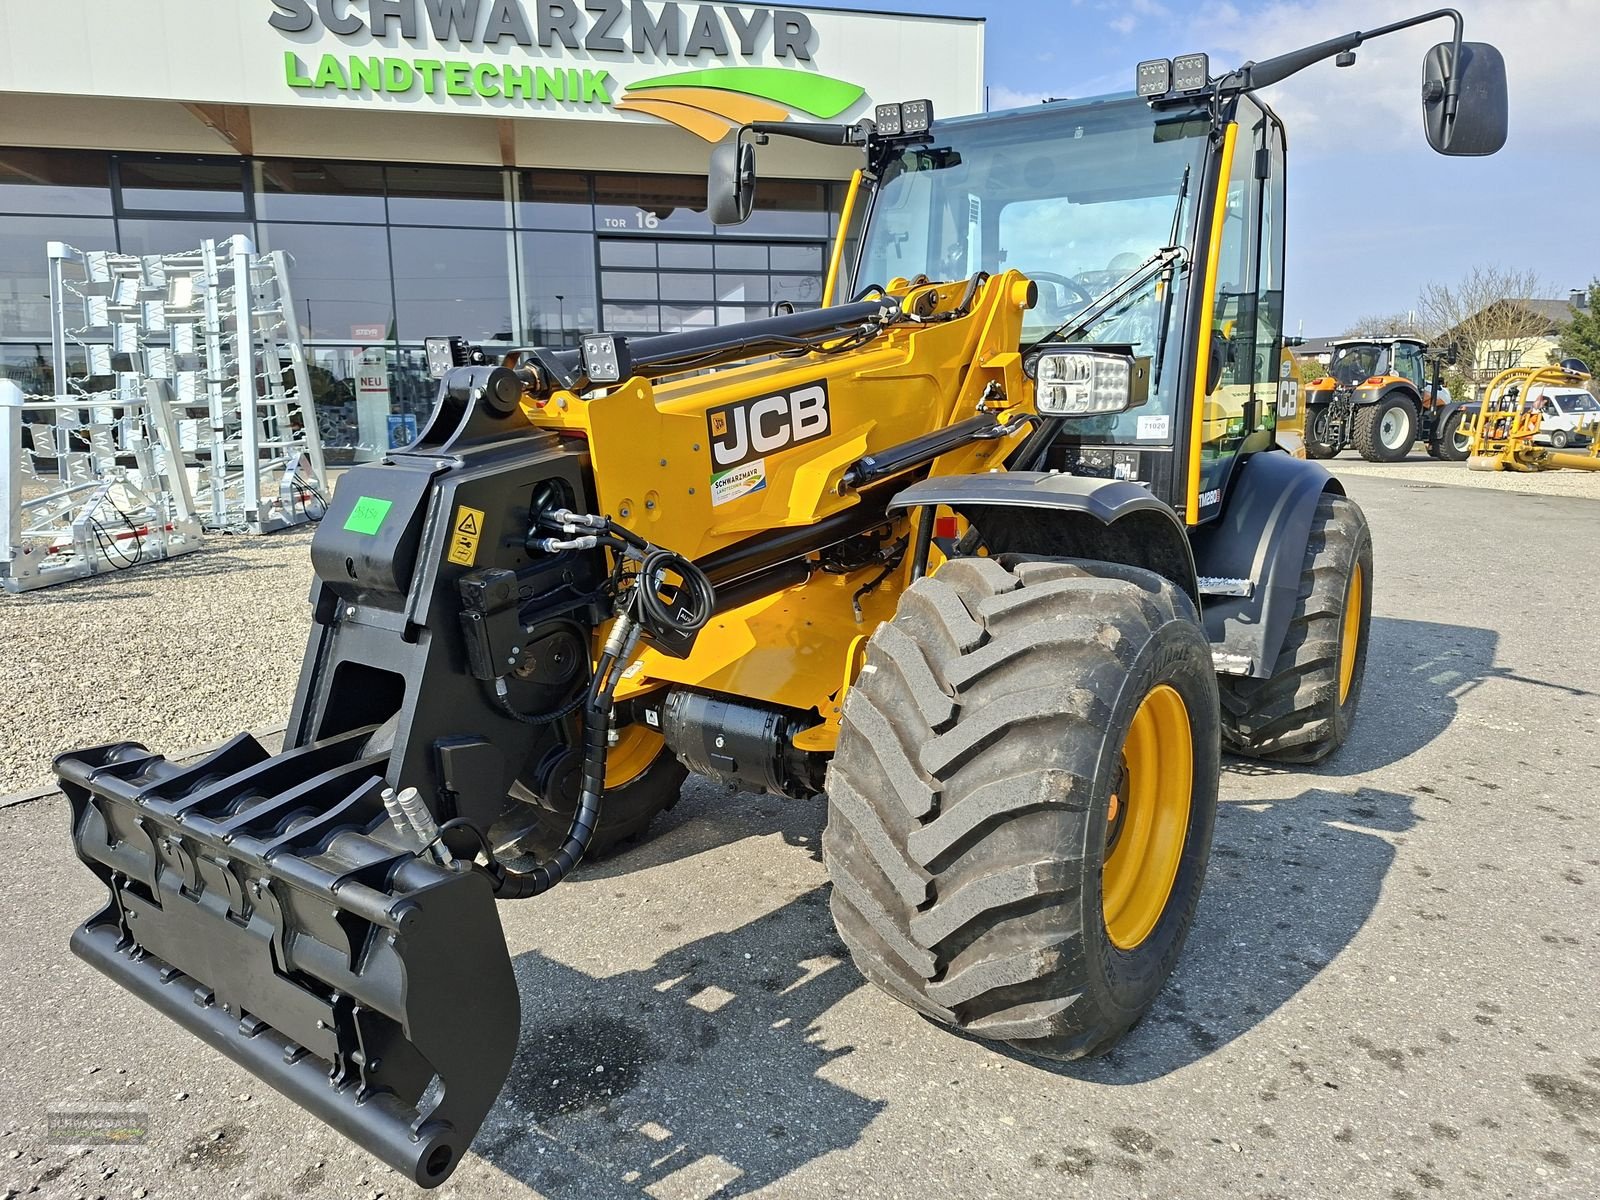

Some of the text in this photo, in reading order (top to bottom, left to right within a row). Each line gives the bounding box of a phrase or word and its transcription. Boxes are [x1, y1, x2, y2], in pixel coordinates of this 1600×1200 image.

[267, 0, 812, 60] SCHWARZMAYR
[284, 51, 612, 104] LANDTECHNIK
[604, 211, 659, 229] TOR 16
[355, 328, 378, 336] STEYR
[360, 377, 382, 387] NEU
[713, 386, 828, 465] JCB
[1144, 422, 1166, 430] 71020
[714, 468, 758, 490] SCHWARZMAYR
